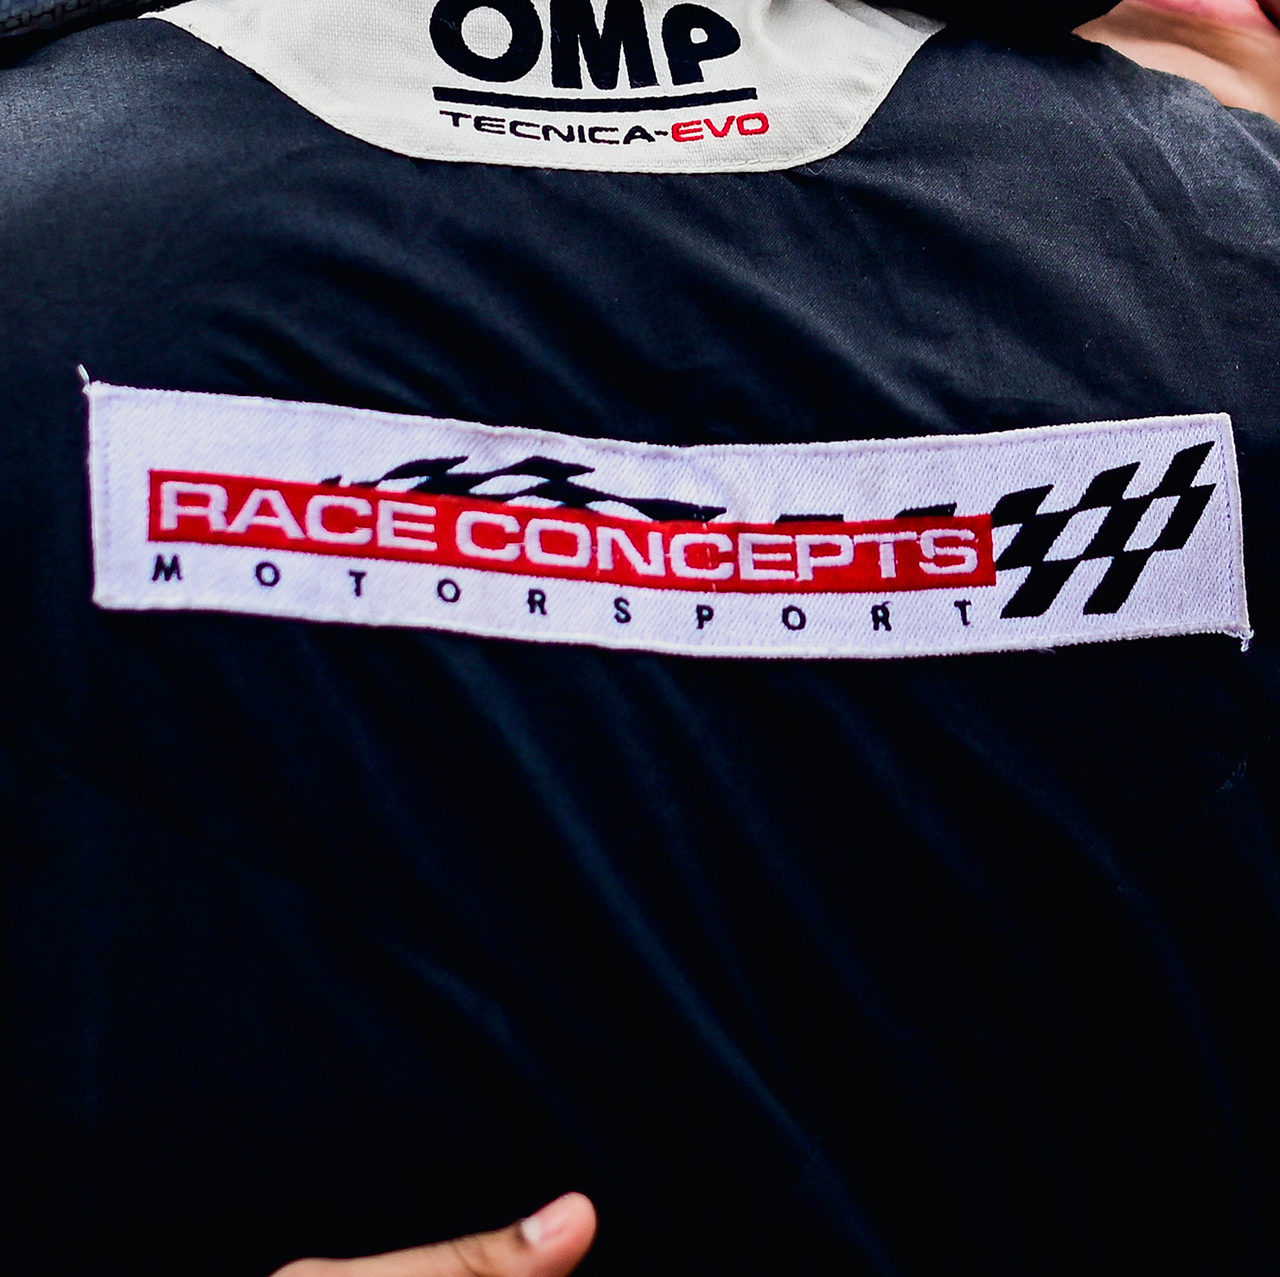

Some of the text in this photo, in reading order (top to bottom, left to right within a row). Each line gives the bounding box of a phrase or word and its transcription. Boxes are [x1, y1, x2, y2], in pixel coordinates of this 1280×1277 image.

[439, 110, 770, 145] TECNICA-EVO
[160, 480, 979, 582] RACE CONCEPTS
[151, 553, 973, 631] MOTORSPORT
